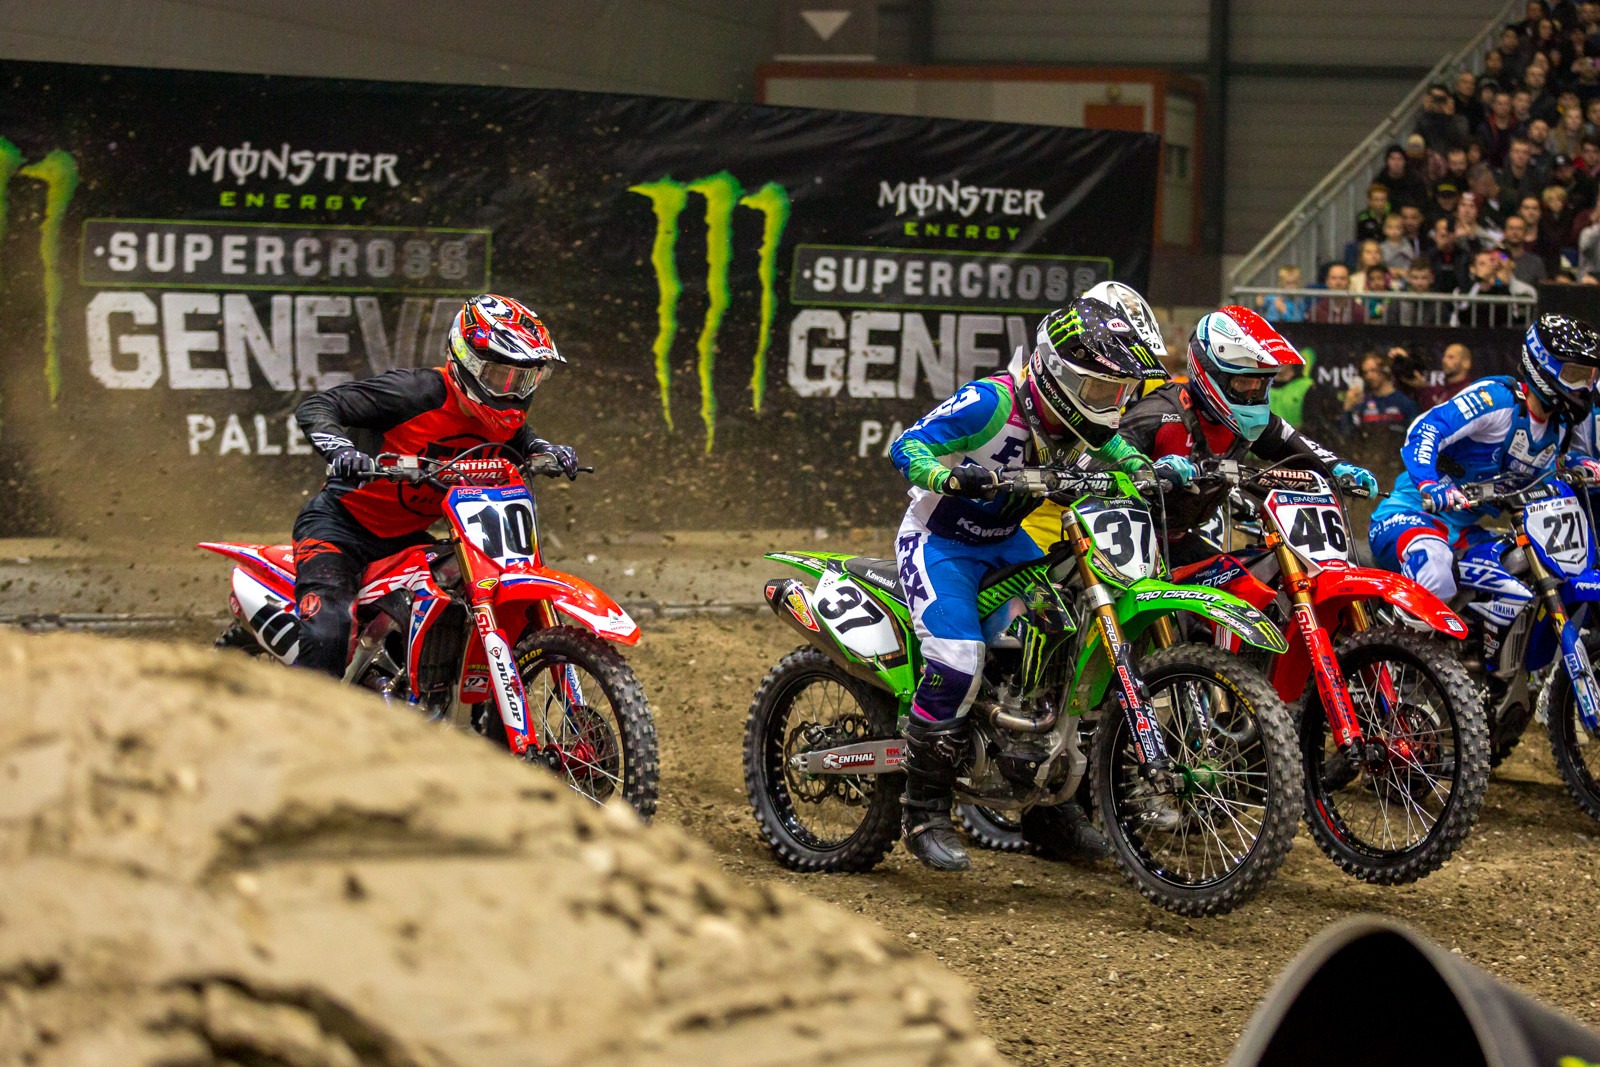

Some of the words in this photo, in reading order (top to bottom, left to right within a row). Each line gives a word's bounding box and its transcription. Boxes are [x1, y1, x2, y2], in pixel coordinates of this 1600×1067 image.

[188, 143, 401, 188] MONSTER
[219, 191, 368, 211] ENERGY
[878, 177, 1046, 221] MONSTER
[904, 221, 1021, 241] ENERGY
[443, 460, 505, 472] ENTHAL
[467, 503, 536, 559] 10
[1094, 510, 1150, 567] 37
[1289, 507, 1347, 552] 46
[1543, 511, 1586, 555] 221
[865, 569, 896, 590] Kawasaki
[1135, 592, 1161, 604] PRO
[1161, 590, 1224, 602] CIRCUIT
[818, 586, 885, 635] 37
[1102, 615, 1118, 642] PRO
[1493, 605, 1515, 616] YAMAHA
[496, 661, 522, 722] DUNLOP
[1118, 666, 1139, 709] BRAKING
[823, 753, 875, 769] RENTHAL
